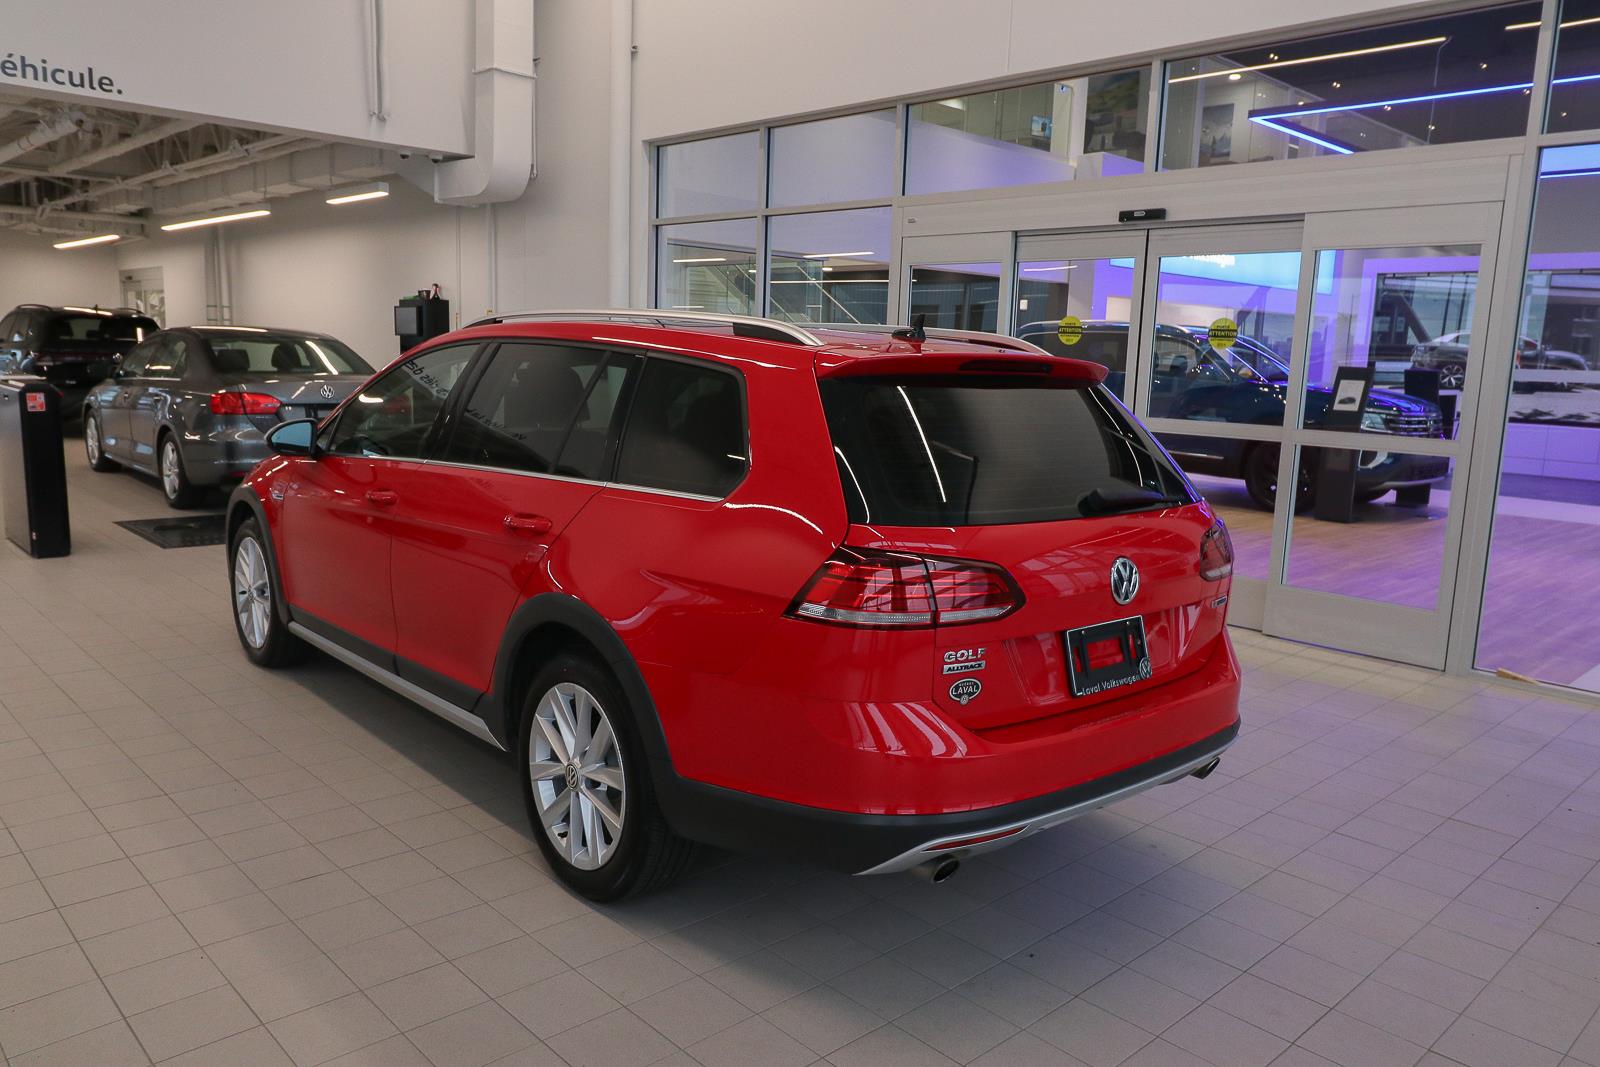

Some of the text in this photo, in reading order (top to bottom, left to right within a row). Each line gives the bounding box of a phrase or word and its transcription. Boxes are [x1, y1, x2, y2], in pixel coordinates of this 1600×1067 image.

[0, 53, 123, 95] éhicule.
[1208, 330, 1238, 338] ATTENTION
[944, 648, 986, 662] GOLF
[946, 662, 983, 672] ALLTRACK
[952, 685, 978, 695] LAVAL
[1082, 673, 1141, 696] Laval Volkswagen
